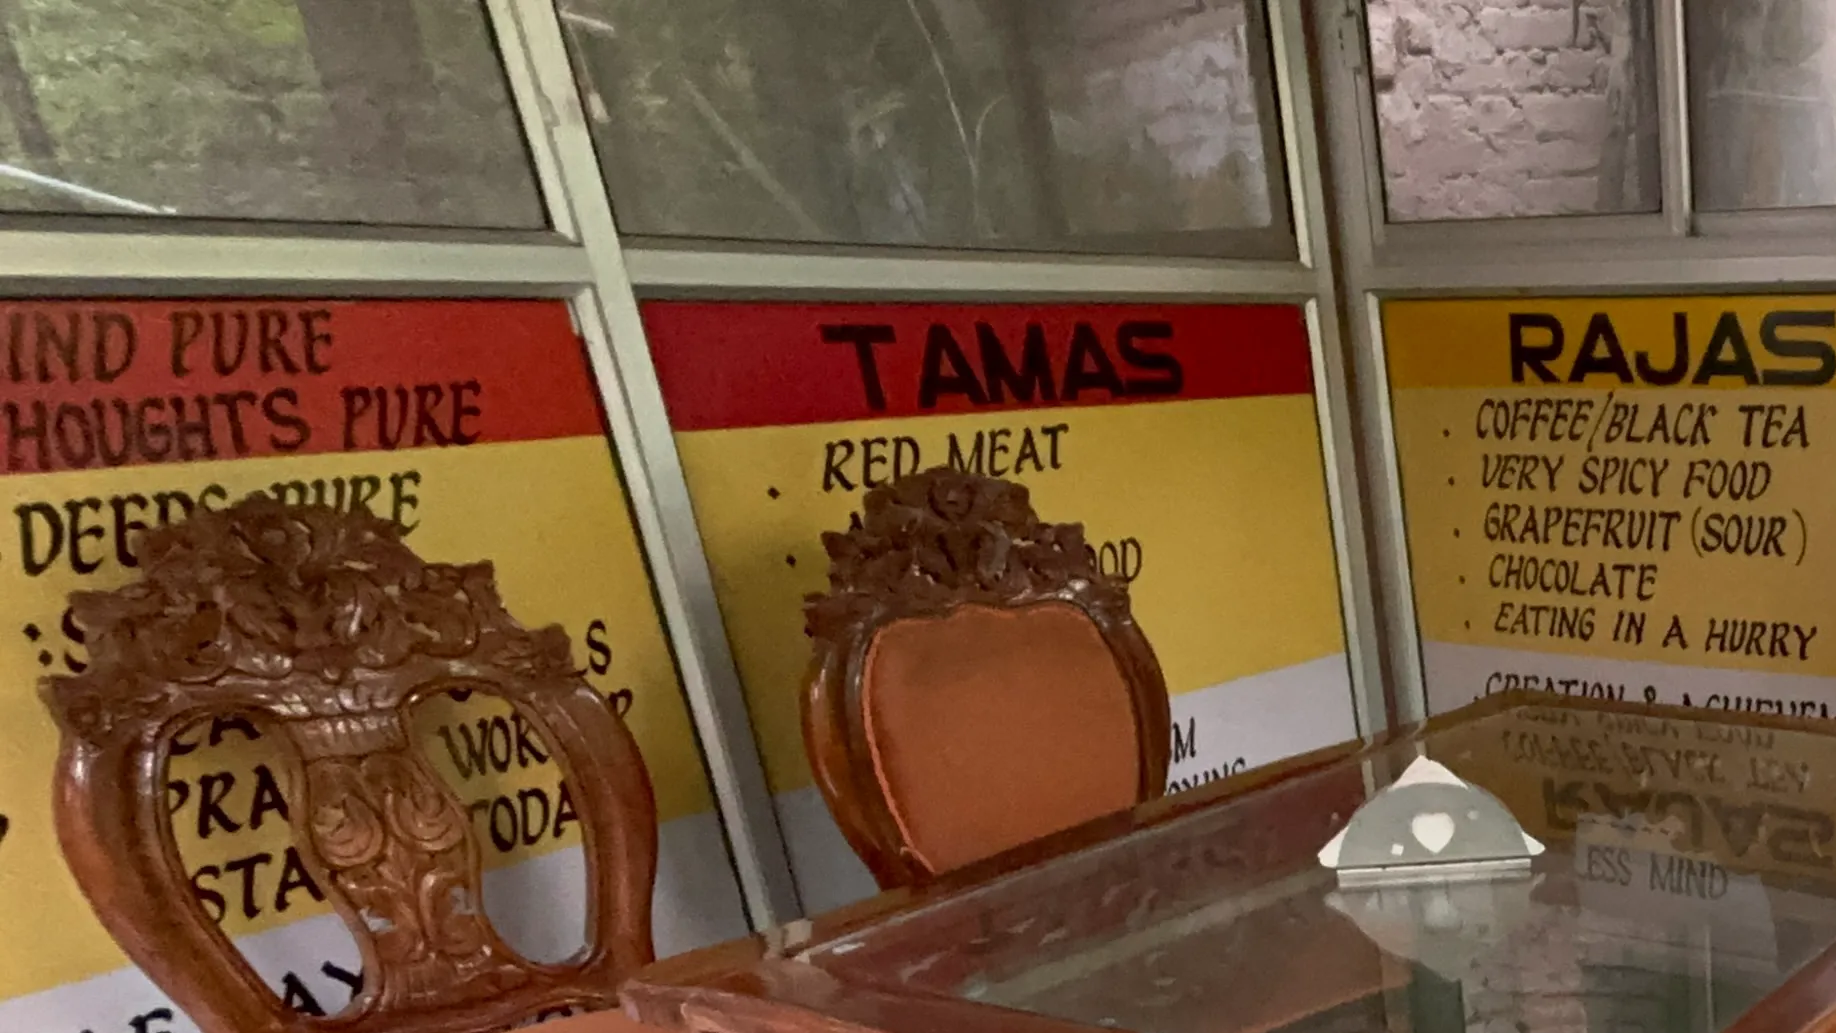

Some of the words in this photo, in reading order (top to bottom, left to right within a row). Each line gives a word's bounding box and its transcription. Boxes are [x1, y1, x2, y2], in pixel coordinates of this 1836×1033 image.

[169, 308, 333, 378] PURE
[821, 320, 1184, 411] TAMAS
[341, 380, 482, 448] PURE
[1475, 391, 1716, 452] COFFEE/BLACK
[1739, 406, 1810, 449] TEA
[822, 436, 920, 492] RED
[948, 423, 1069, 478] MEAT
[1480, 455, 1564, 492] VERY
[1578, 459, 1670, 499] SPICY
[1683, 460, 1771, 501] FOOD
[1484, 502, 1681, 553] GRAPEFRUIT
[1691, 508, 1808, 566] (SOUR)
[1488, 553, 1658, 601] CHOCOLATE
[1494, 603, 1596, 643] EATING
[1612, 612, 1646, 646] IN
[1663, 615, 1688, 652] A
[1705, 618, 1818, 662] HURRY
[1650, 853, 1729, 900] MIND
